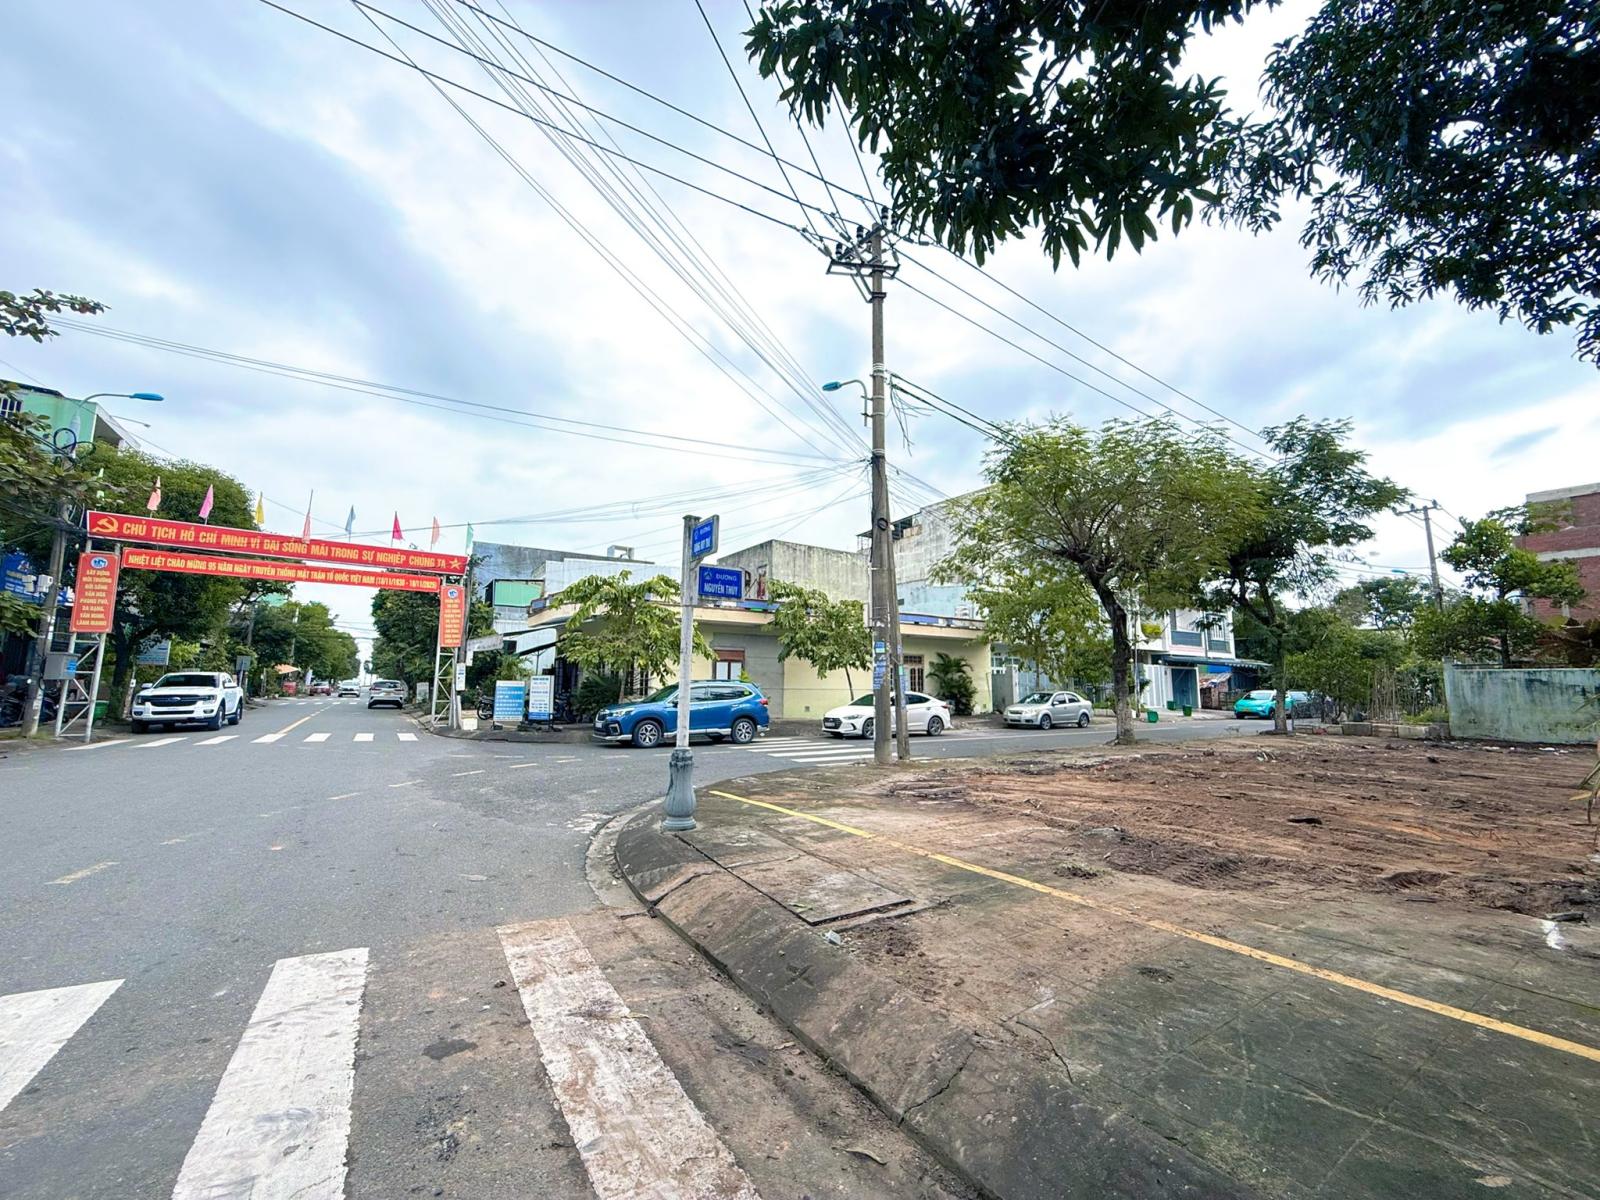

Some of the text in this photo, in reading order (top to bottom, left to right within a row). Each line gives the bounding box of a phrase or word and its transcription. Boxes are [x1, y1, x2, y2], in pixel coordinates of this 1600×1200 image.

[122, 521, 147, 536] CHỦ
[151, 525, 177, 540] TỊCH
[180, 526, 195, 541] HỒ
[199, 530, 218, 544] CHÍ
[221, 534, 248, 547] MINH
[263, 538, 280, 553] ĐẠI
[282, 537, 308, 554] SỐNG
[330, 546, 359, 560] TRONG
[362, 550, 375, 564] SỰ
[376, 551, 406, 565] NGHIỆP
[409, 554, 435, 568] CHÚNG
[436, 559, 446, 569] TA
[128, 554, 150, 566] NHIỆT
[150, 555, 166, 568] LIỆT
[166, 557, 185, 568] CHÀO
[186, 558, 207, 570] MỪNG
[207, 562, 217, 571] 95
[217, 562, 233, 573] NĂM
[234, 563, 251, 574] NGÀY
[252, 565, 276, 576] TRUYỀN
[276, 566, 297, 578] THỐNG
[334, 571, 350, 582] QUỐC
[362, 575, 375, 584] NAM
